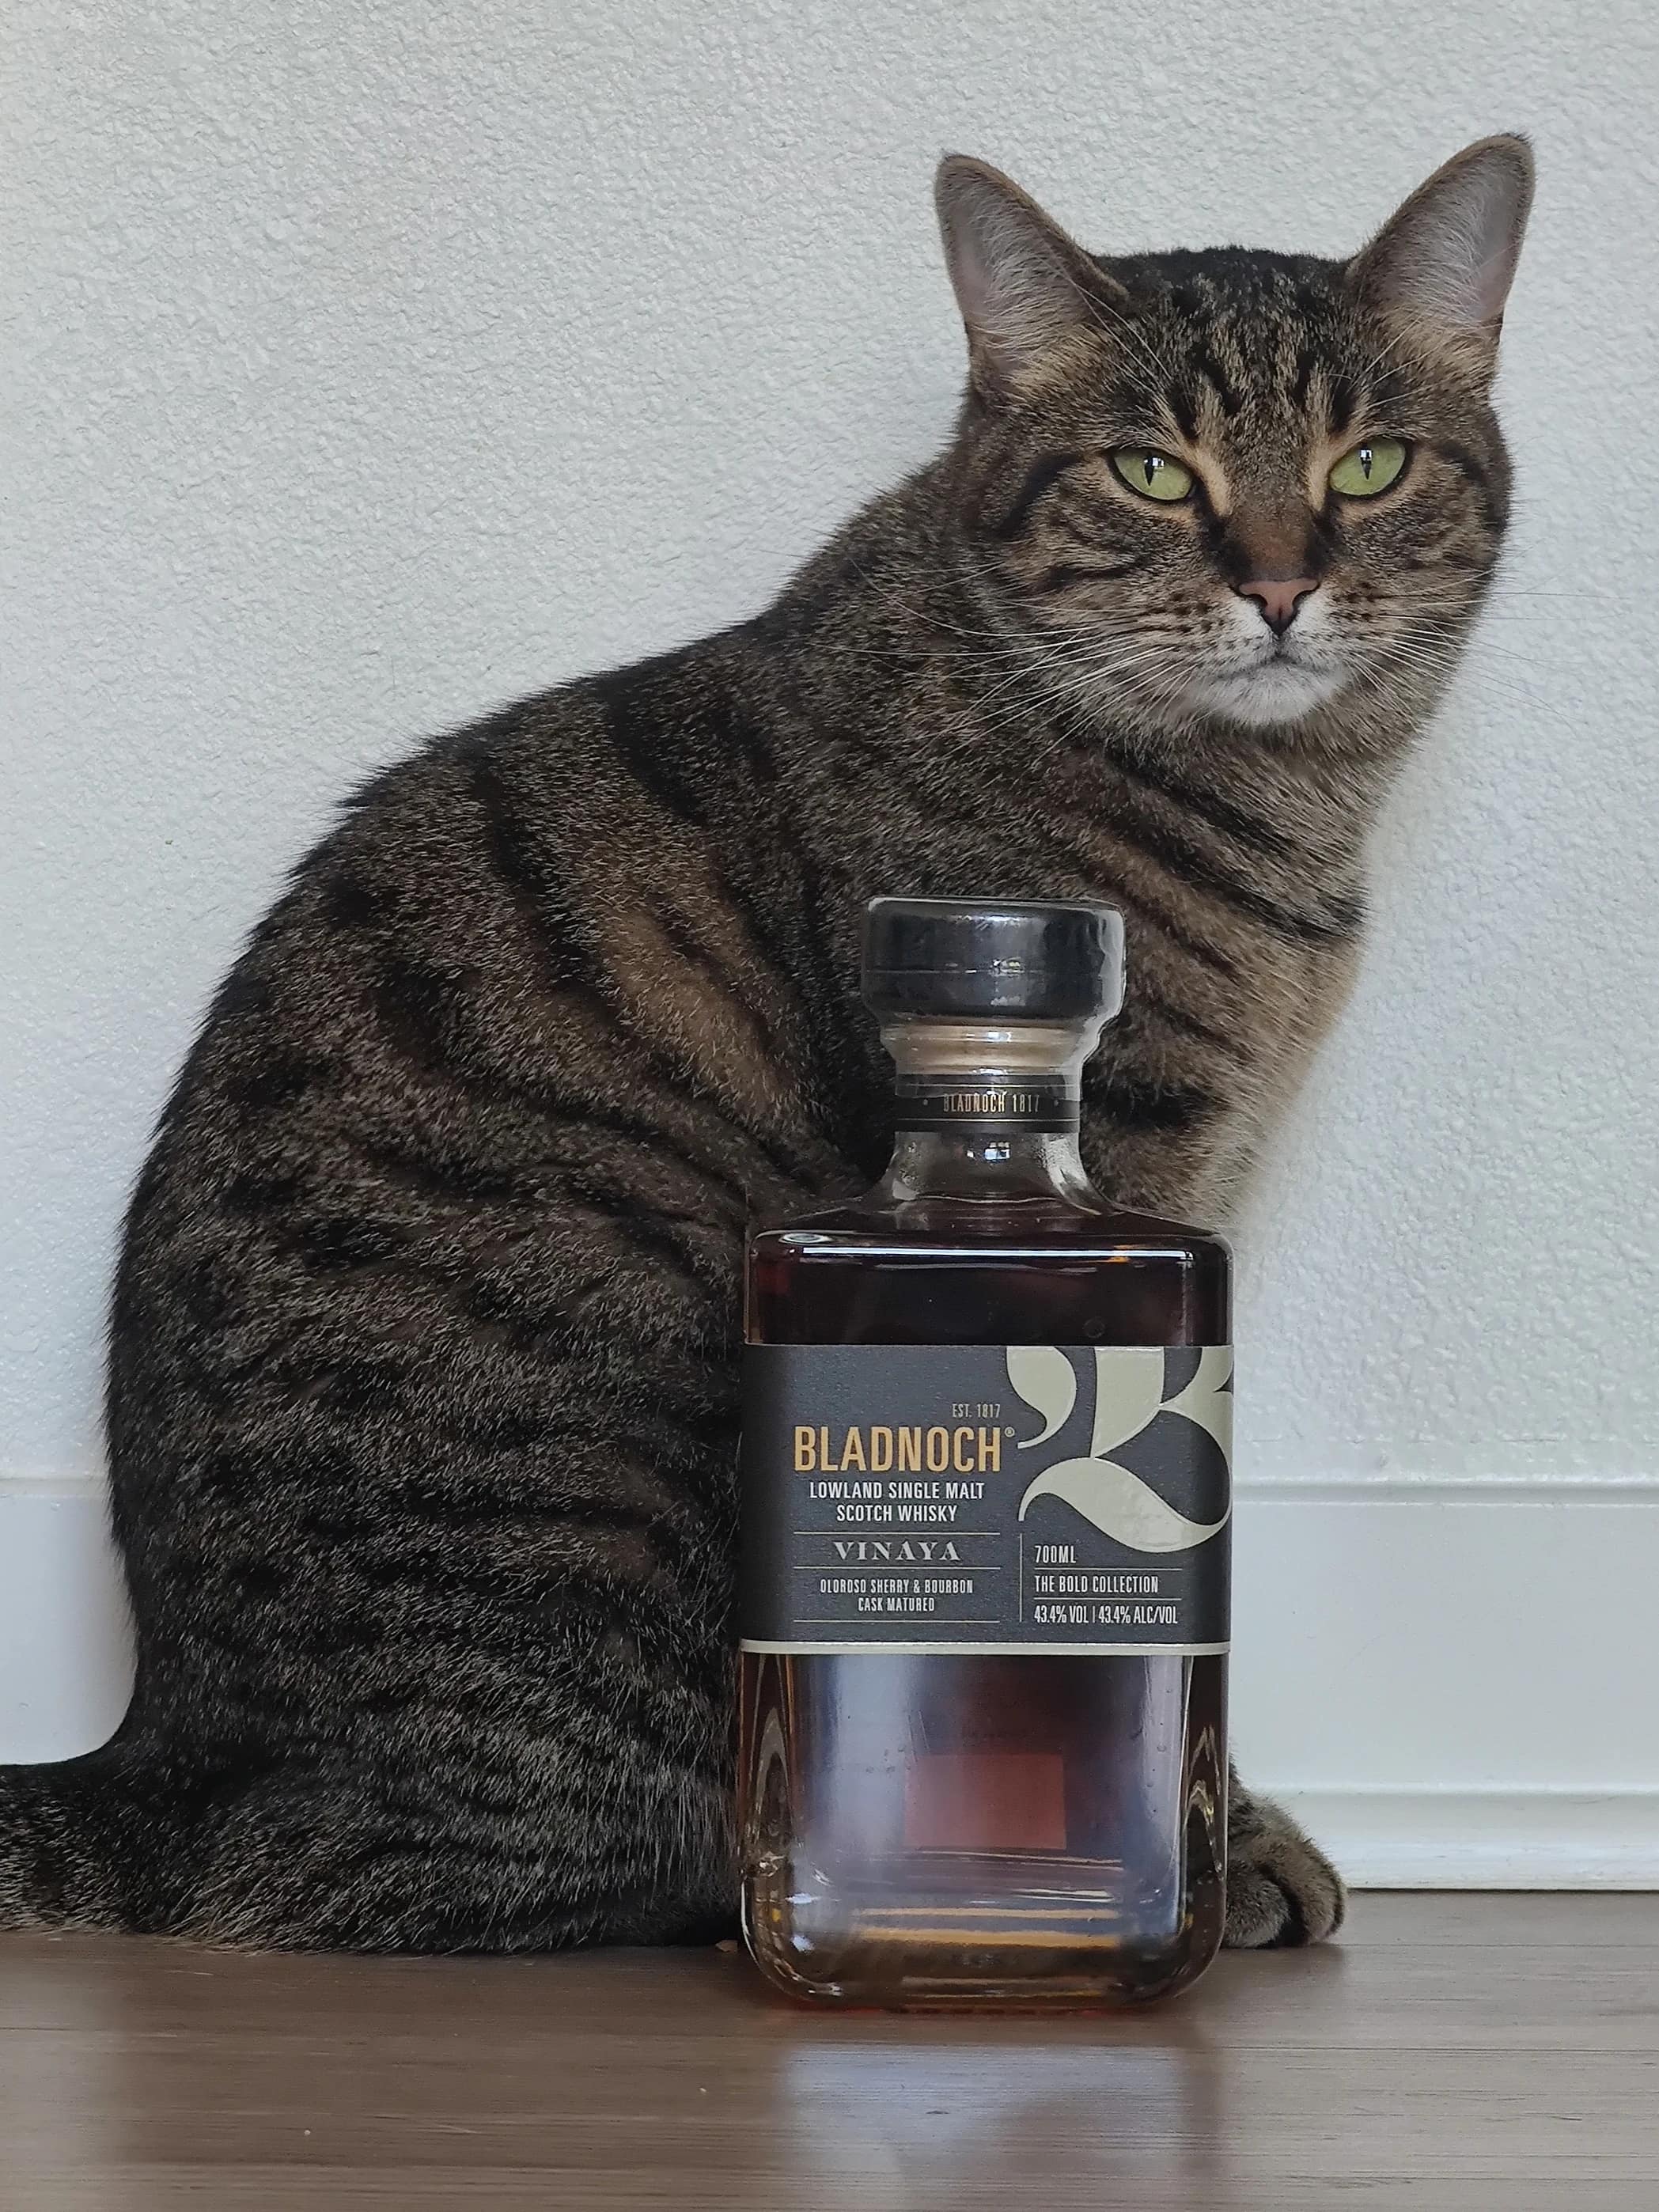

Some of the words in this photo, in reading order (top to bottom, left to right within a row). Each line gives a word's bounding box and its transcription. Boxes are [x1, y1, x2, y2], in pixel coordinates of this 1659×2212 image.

[943, 1093, 1006, 1113] BLADNOCH
[1012, 1094, 1040, 1113] 1817
[953, 1403, 972, 1418] EST.
[977, 1403, 1000, 1418] 1817
[809, 1481, 882, 1499] LOWLAND
[888, 1482, 939, 1499] SINGLE
[945, 1482, 985, 1499] MALT
[836, 1504, 892, 1521] SCOTCH
[898, 1505, 957, 1521] WHISKY
[833, 1540, 961, 1561] VINAYA
[1034, 1545, 1077, 1563] 700ML
[820, 1578, 867, 1593] OLOROSO
[870, 1579, 909, 1593] SHERRY
[913, 1580, 920, 1593] &
[925, 1580, 973, 1594] BOURBON
[1034, 1575, 1055, 1592] THE
[1059, 1575, 1089, 1593] BOLD
[1093, 1575, 1158, 1593] COLLECTION
[858, 1597, 883, 1612] CASK
[887, 1597, 935, 1612] MATURED
[1034, 1604, 1067, 1623] 43.4%
[1069, 1605, 1089, 1623] VOL
[1098, 1605, 1131, 1623] 43.4%
[1133, 1605, 1178, 1624] ALC/VOL
